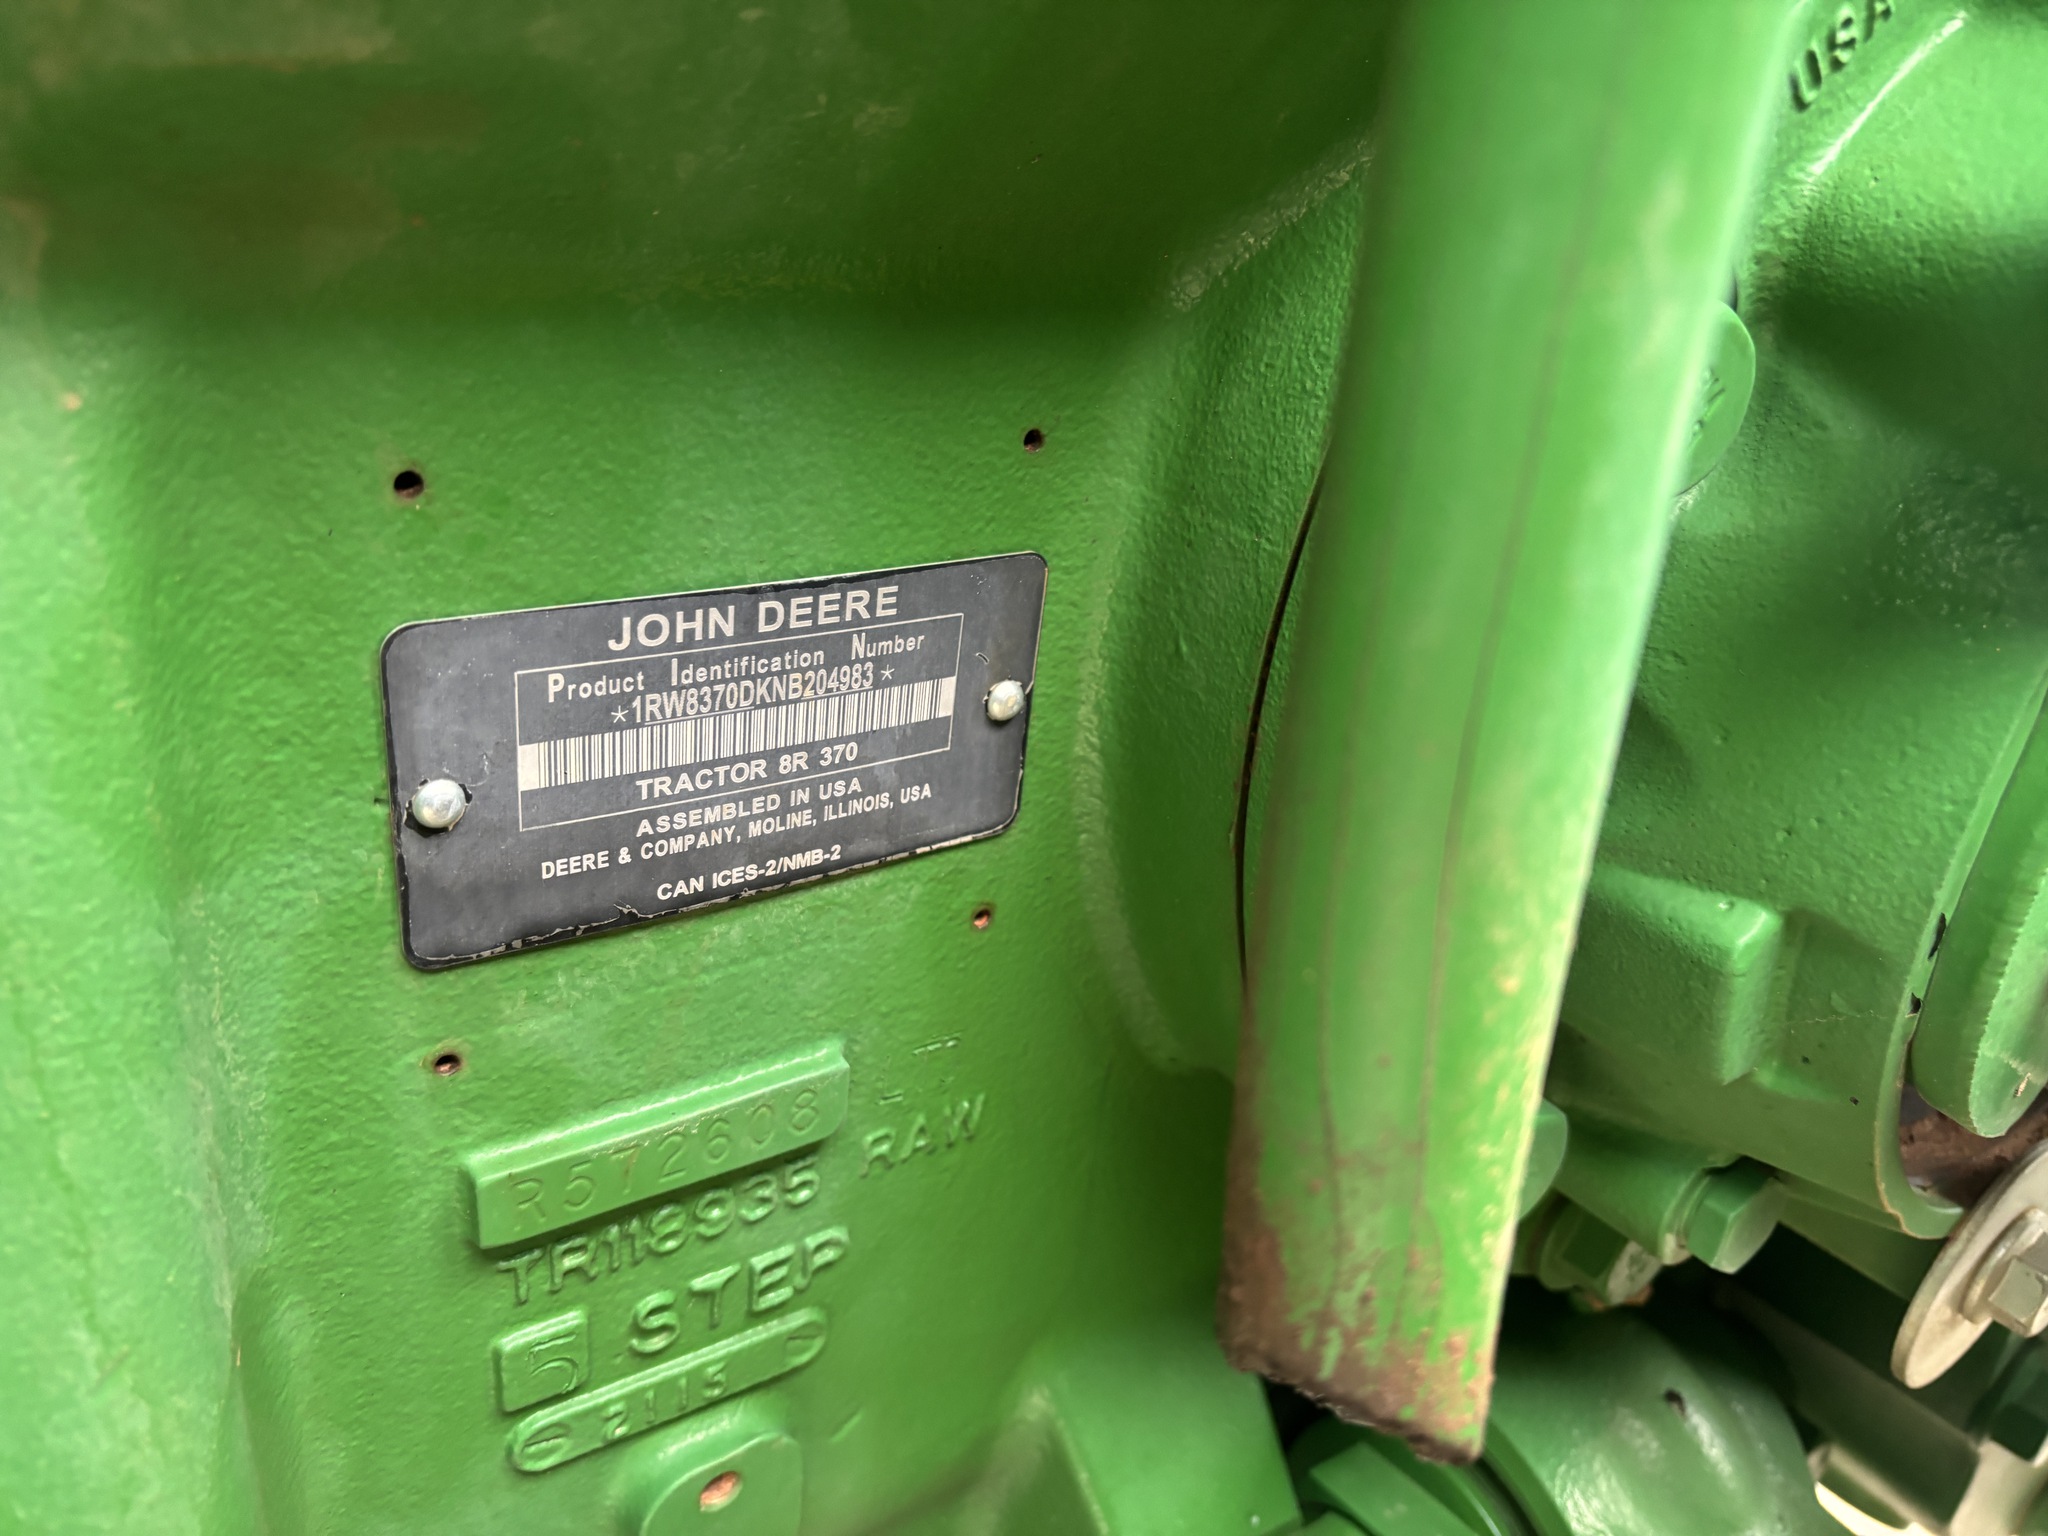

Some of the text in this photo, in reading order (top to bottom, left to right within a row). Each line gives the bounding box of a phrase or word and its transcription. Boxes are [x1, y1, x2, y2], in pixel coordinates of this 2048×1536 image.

[1788, 0, 1893, 113] USA
[608, 585, 899, 651] JOHN DEERE
[547, 632, 925, 703] Product Identification Number
[636, 741, 859, 800] TRACTOR 8R 370
[541, 783, 932, 879] DEERE & COMPANY, MOLINE, ILLINOIS, USA
[635, 777, 863, 838] ASSEMBLED IN USA
[656, 844, 841, 901] CAN ICES-2/NMB-2
[509, 1089, 820, 1232] R572608
[859, 1092, 985, 1179] RAW
[629, 1225, 849, 1354] STEP
[526, 1333, 579, 1394] 5
